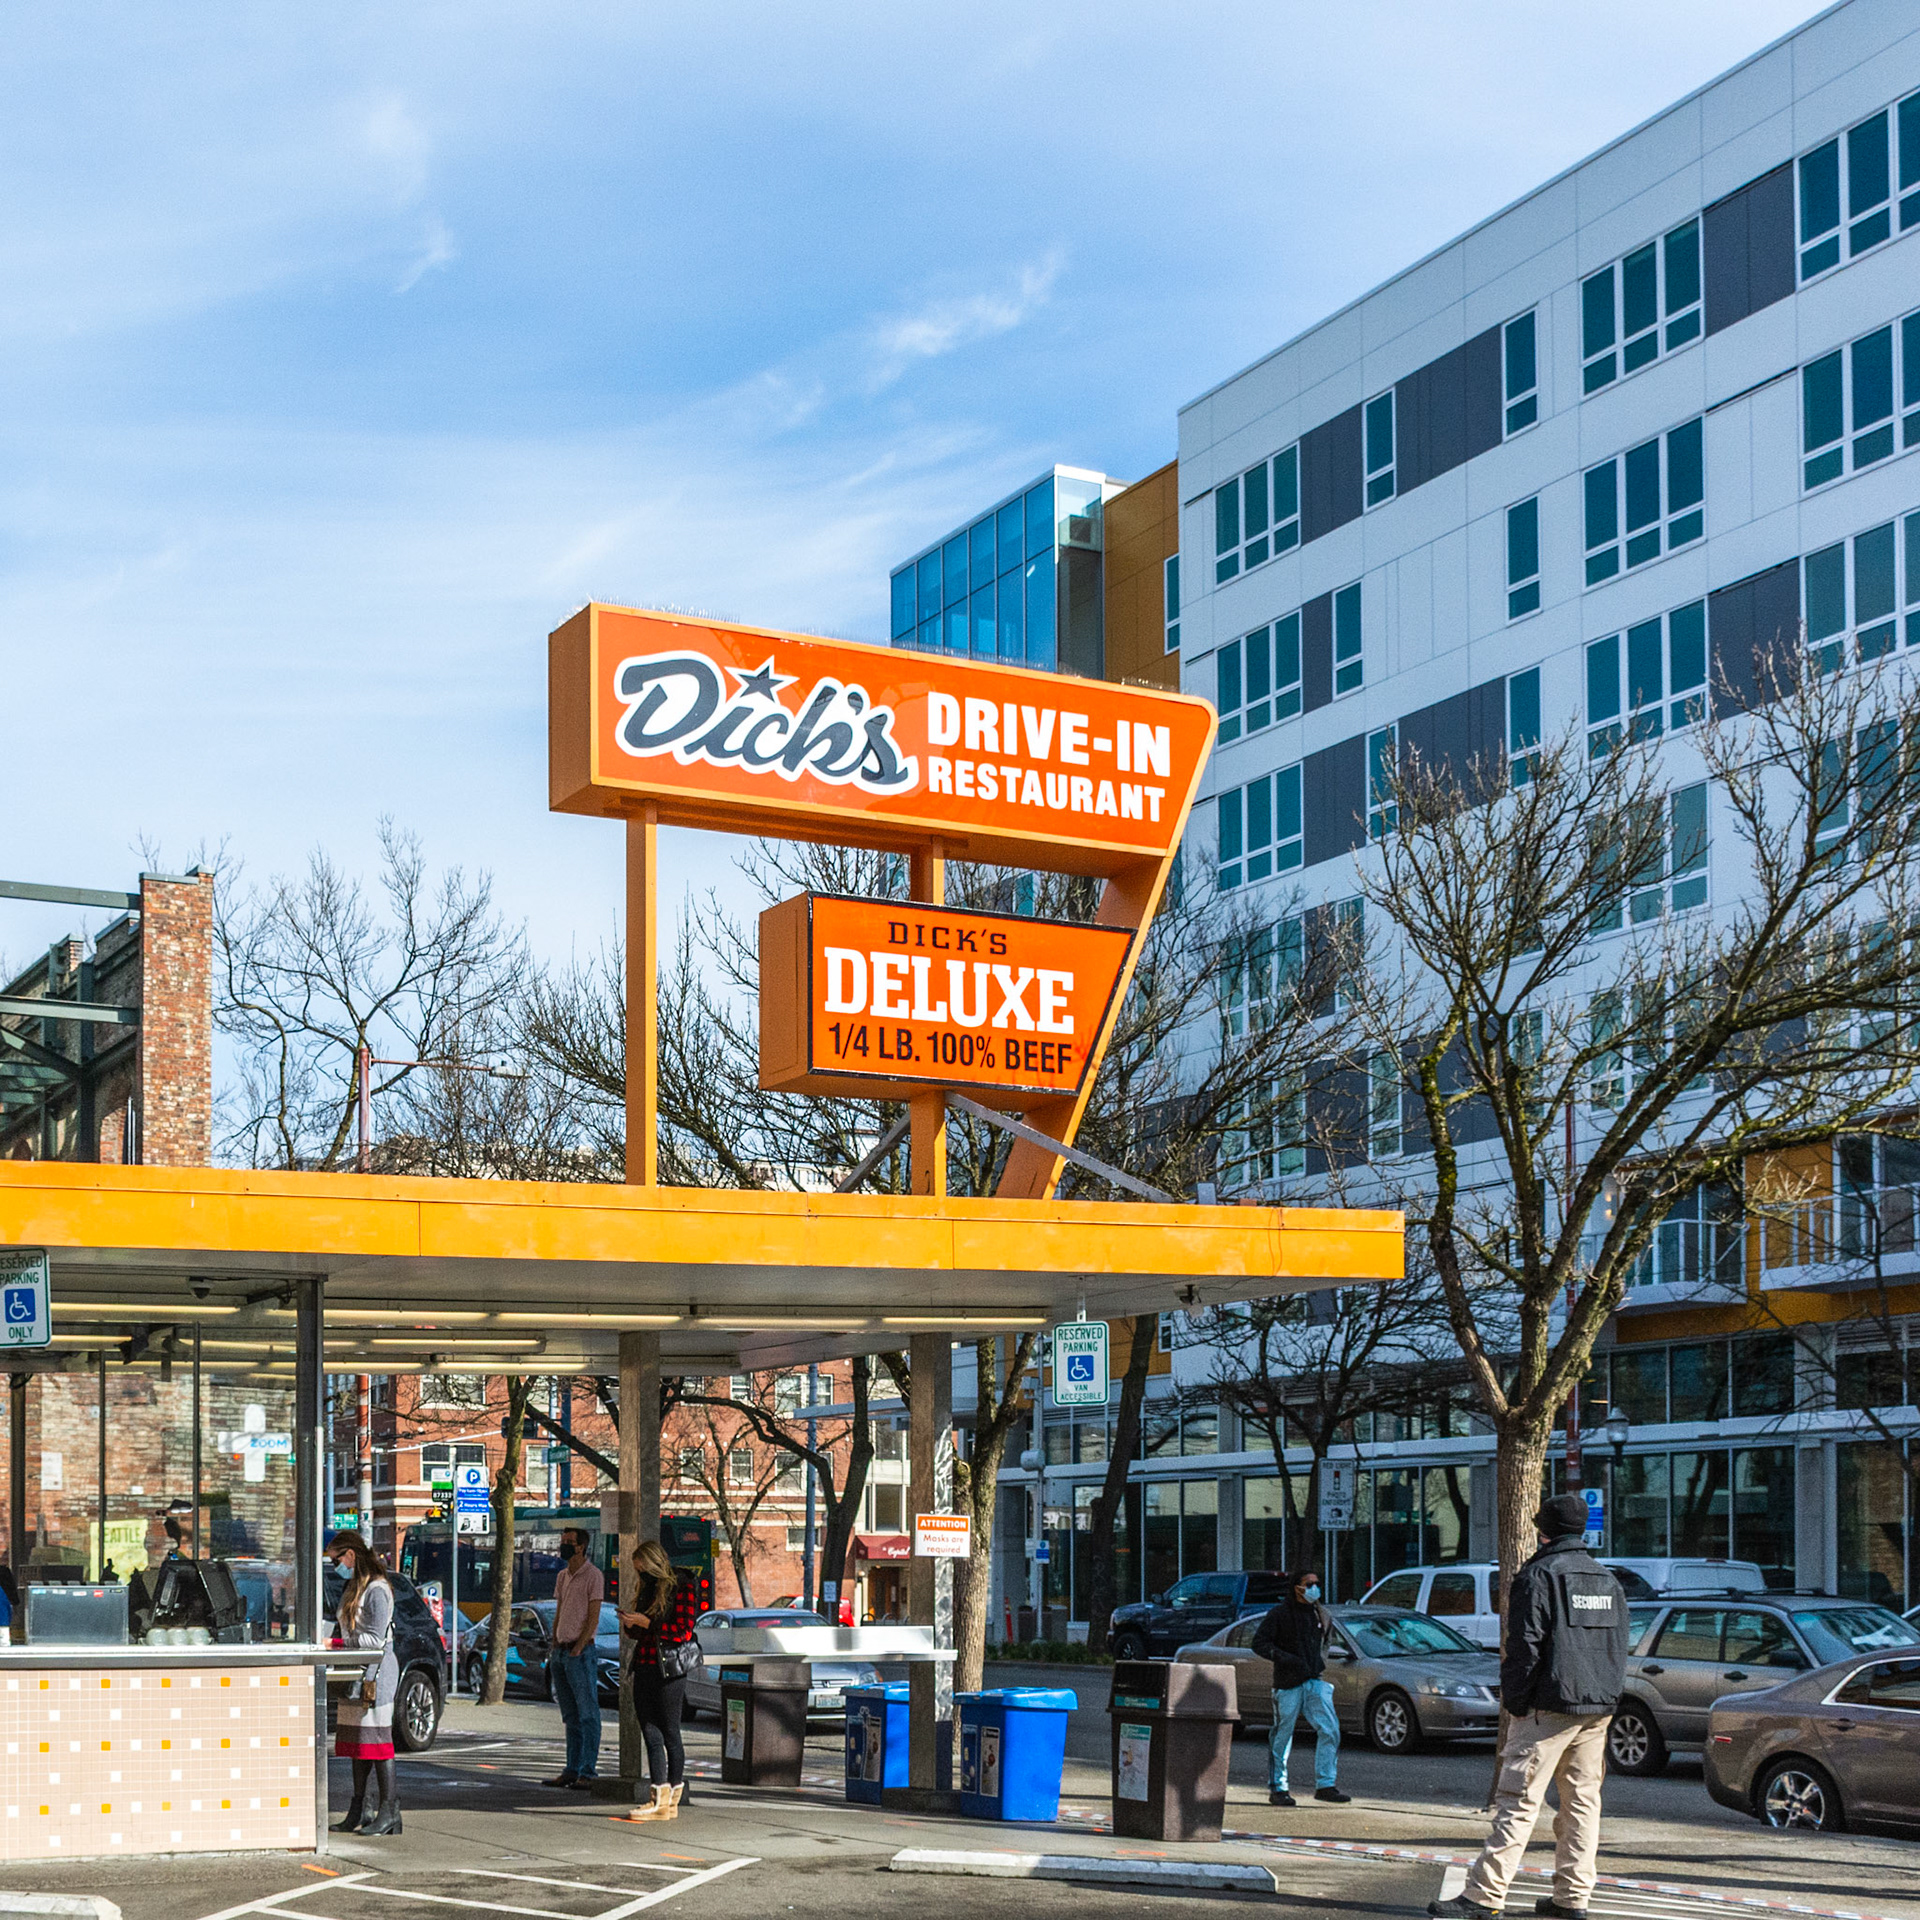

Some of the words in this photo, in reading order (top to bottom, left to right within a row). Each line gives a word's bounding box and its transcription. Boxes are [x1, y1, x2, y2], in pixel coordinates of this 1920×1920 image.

[614, 650, 919, 795] Dick's
[927, 691, 1171, 777] DRIVE-IN
[928, 755, 1166, 823] RESTAURANT
[889, 921, 1008, 956] DICK'S
[824, 948, 1075, 1036] DELUXE
[829, 1023, 870, 1060] 1/4
[879, 1032, 920, 1064] LB.
[928, 1034, 996, 1068] 100%
[1005, 1040, 1073, 1075] BEEF
[0, 1256, 43, 1269] ESERVED
[0, 1272, 40, 1284] PARKING
[8, 1326, 34, 1339] ONLY
[1058, 1327, 1103, 1341] RESERVED
[1063, 1342, 1098, 1353] PARKING
[1074, 1384, 1088, 1392] VAN
[1061, 1392, 1102, 1401] ACCESSIBLE
[250, 1438, 288, 1448] ZOOM
[920, 1520, 966, 1528] ATTENTION
[103, 1527, 141, 1544] EATTLE
[923, 1534, 949, 1542] Masks
[926, 1546, 961, 1554] required
[1572, 1594, 1612, 1609] SECURITY
